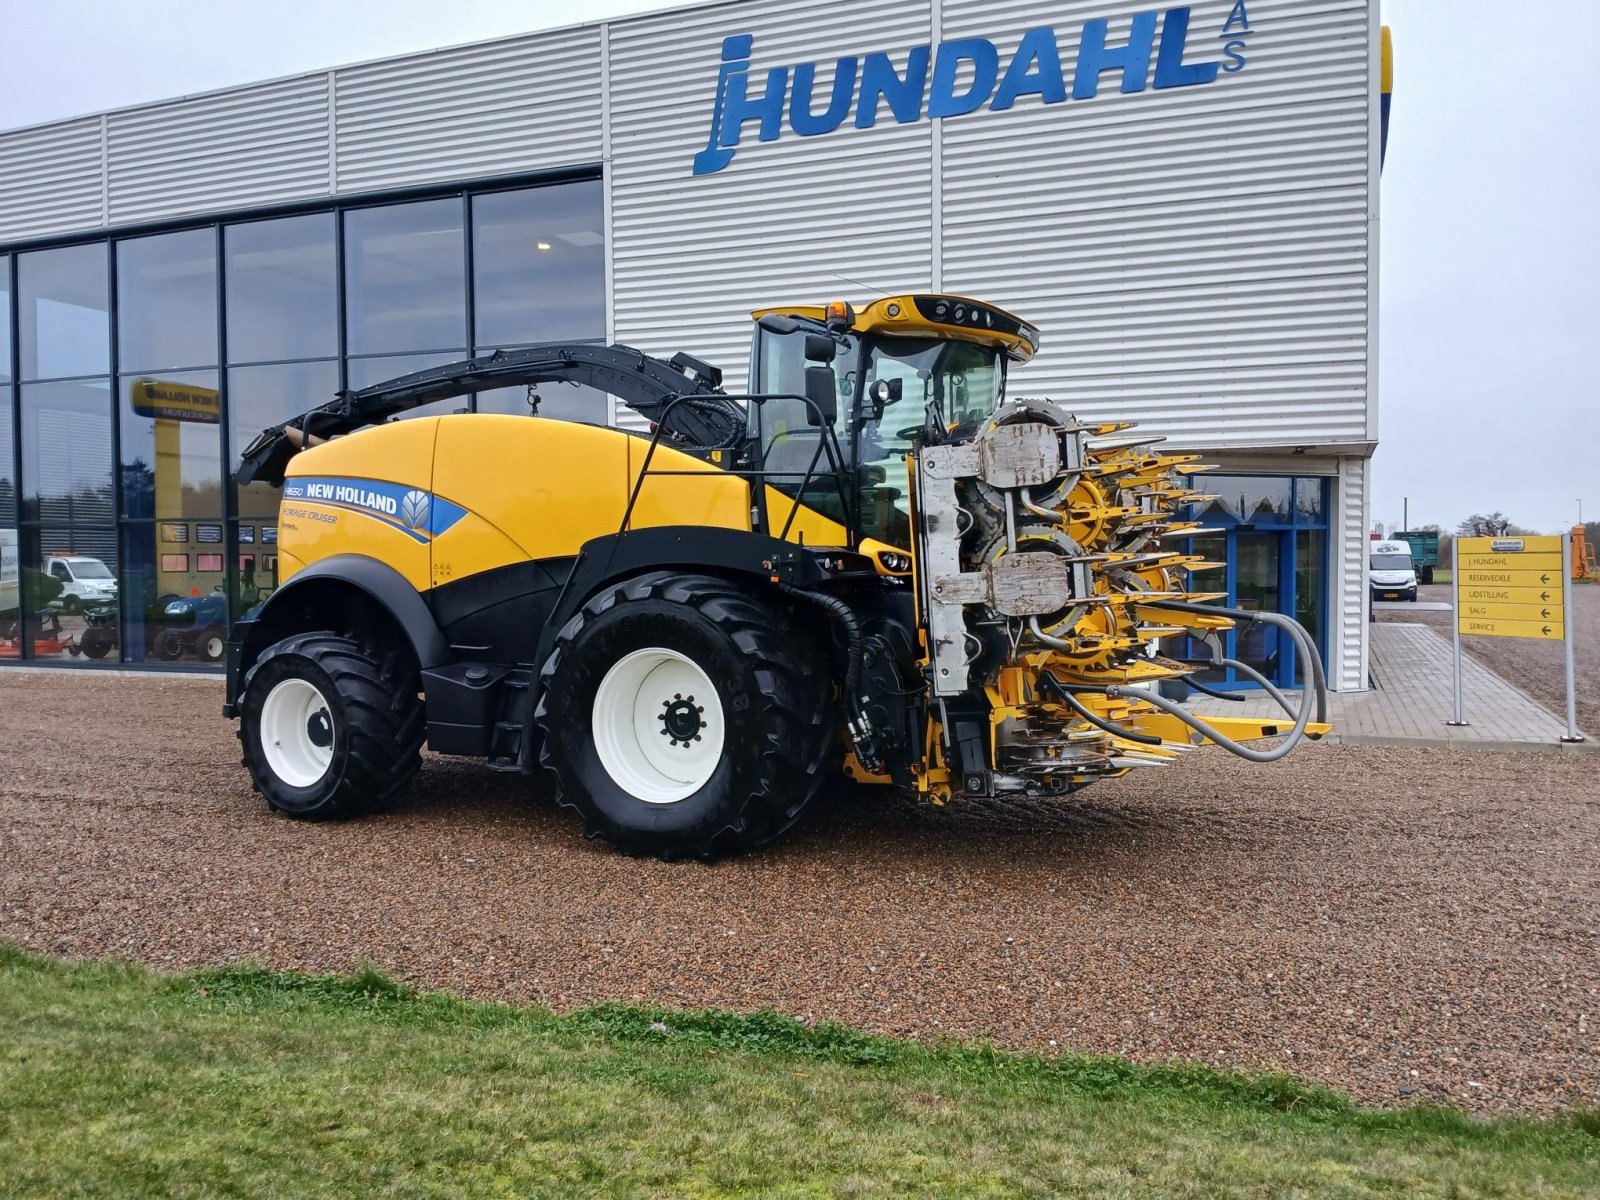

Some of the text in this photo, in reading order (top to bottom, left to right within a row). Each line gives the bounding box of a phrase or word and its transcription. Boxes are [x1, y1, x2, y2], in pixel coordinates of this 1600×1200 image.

[306, 483, 334, 499] NEW
[336, 486, 397, 514] HOLLAND
[283, 508, 338, 524] FORAGE CRUISER
[1473, 558, 1508, 566] HUNDAHL
[1468, 574, 1512, 582] RESERVEDELE
[1468, 591, 1509, 599] UDSTILLING
[1469, 607, 1487, 615] SALG
[1469, 623, 1496, 631] SERVICE
